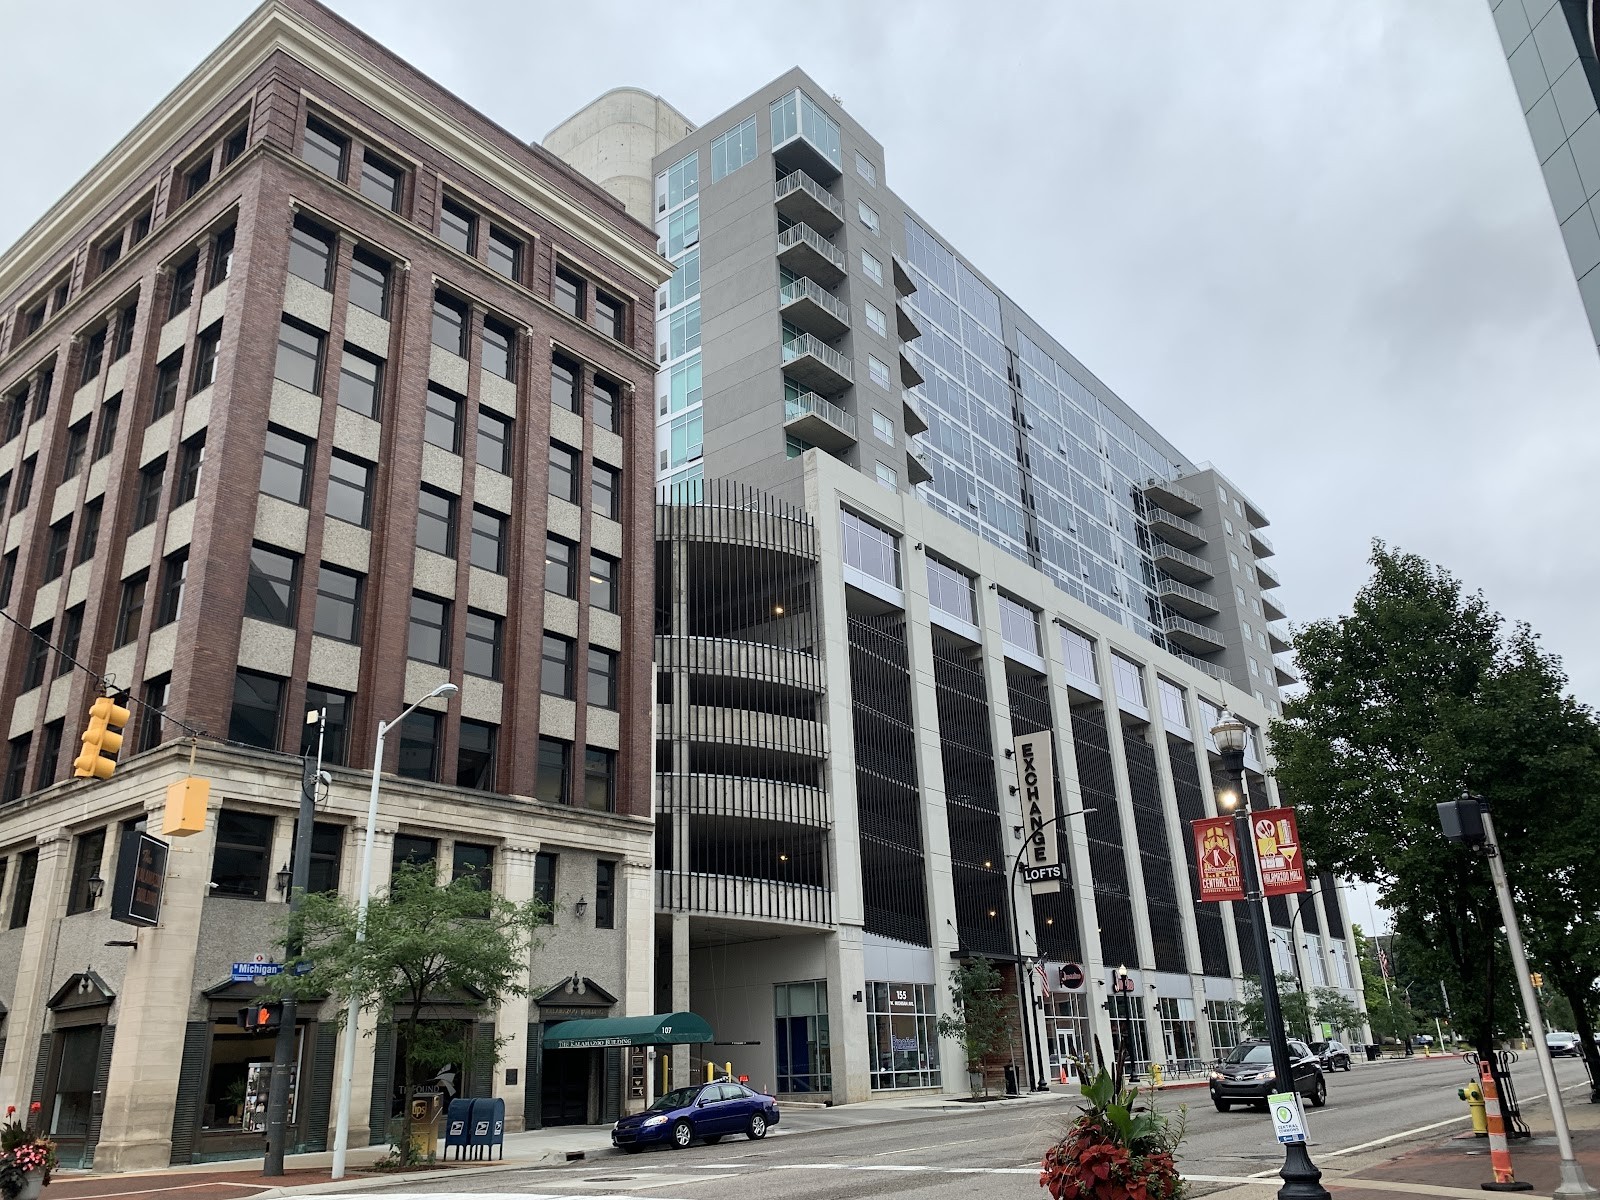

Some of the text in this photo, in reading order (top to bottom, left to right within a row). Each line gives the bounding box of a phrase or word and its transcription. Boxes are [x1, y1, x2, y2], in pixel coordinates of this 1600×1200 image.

[1021, 743, 1047, 862] EXCHANGE
[1024, 866, 1061, 881] LOFTS
[1202, 876, 1240, 889] CENTRAL CITY
[239, 963, 277, 975] Michigan
[896, 990, 907, 1000] 155
[661, 1026, 672, 1034] 107
[570, 1039, 604, 1047] KALAMAZOO
[605, 1037, 631, 1046] BUILDING
[412, 1105, 426, 1118] ups
